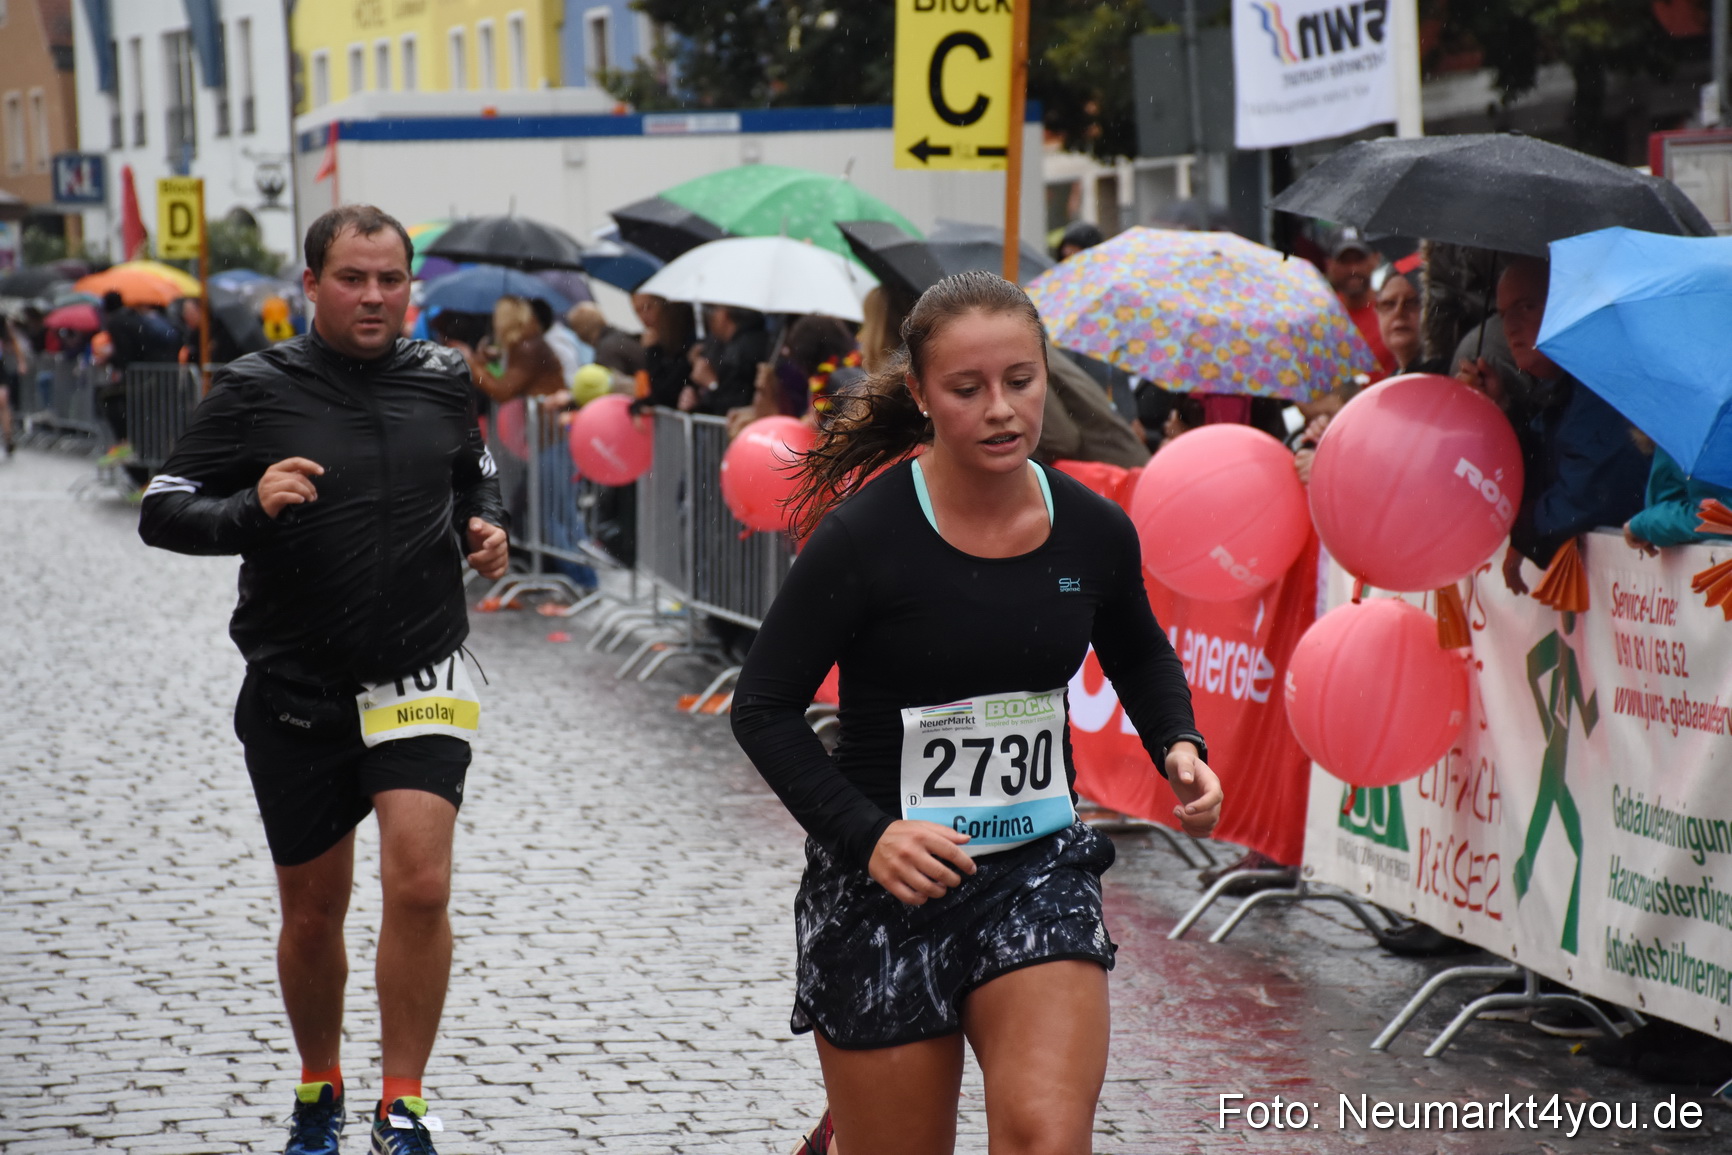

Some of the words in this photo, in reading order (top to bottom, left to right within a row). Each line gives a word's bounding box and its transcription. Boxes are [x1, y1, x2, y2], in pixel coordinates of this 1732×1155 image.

[929, 30, 992, 128] C
[169, 202, 192, 238] D
[397, 703, 454, 725] Nicolay
[920, 716, 976, 729] NeuerMarkt
[985, 696, 1055, 720] BOCK
[923, 730, 1053, 798] 2730
[953, 815, 1034, 839] Corinna
[1612, 783, 1732, 866] Gebäudereinigun
